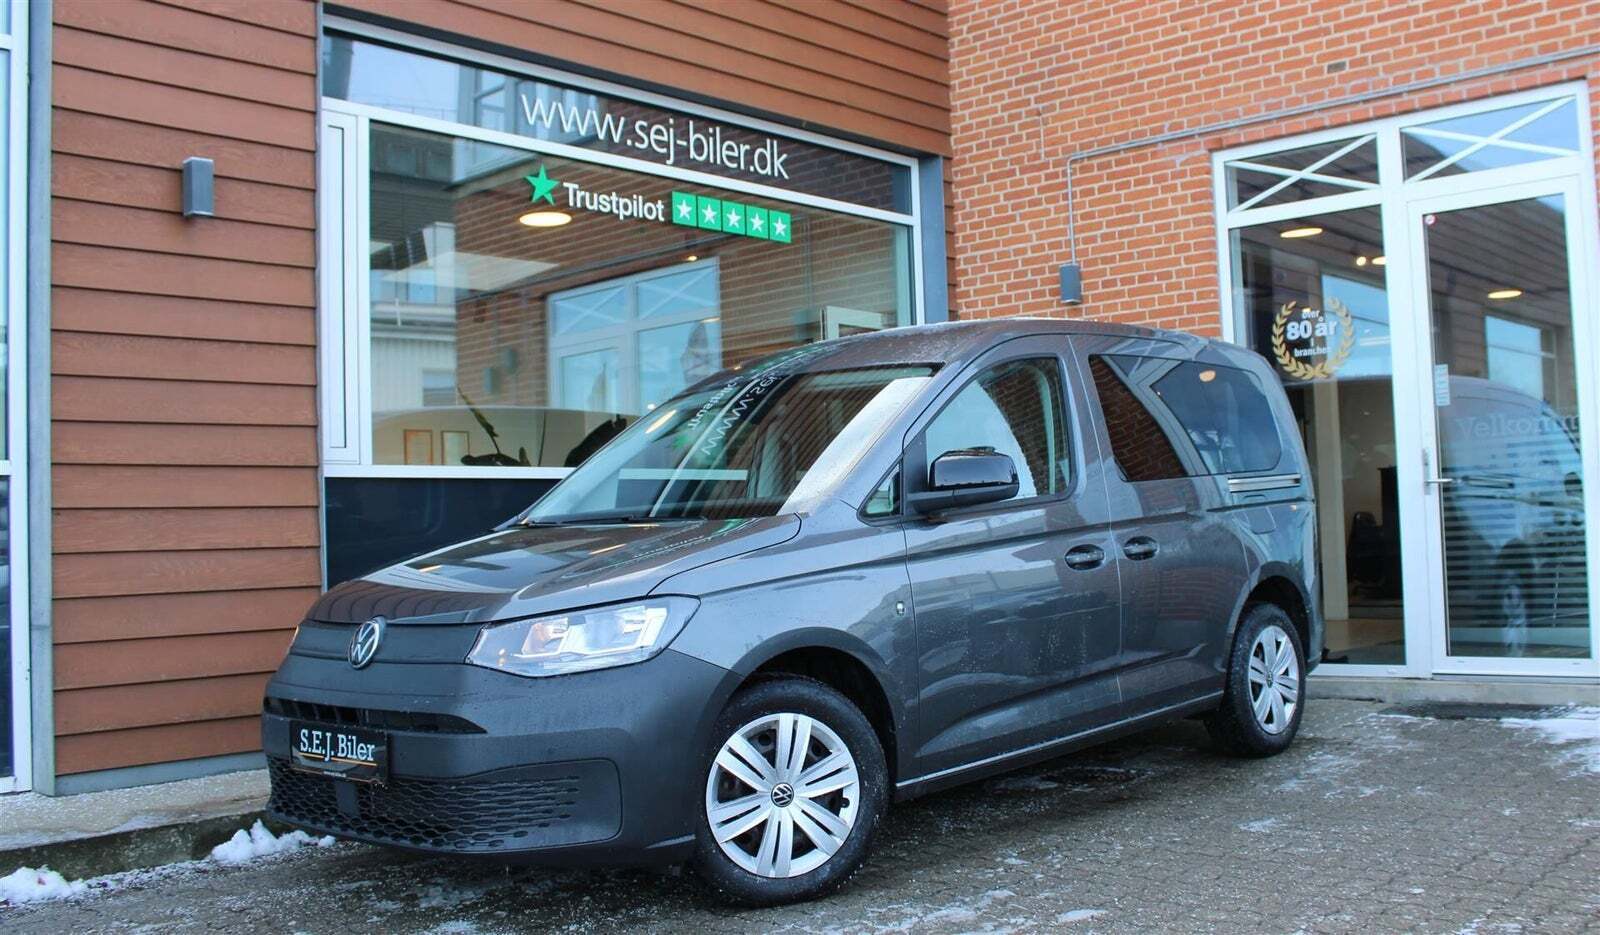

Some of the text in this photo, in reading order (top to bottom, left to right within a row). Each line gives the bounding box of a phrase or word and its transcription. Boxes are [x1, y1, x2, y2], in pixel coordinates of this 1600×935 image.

[521, 94, 790, 180] www.sej-biler.dk
[563, 182, 666, 222] Trustpilot
[1286, 316, 1338, 340] 80 år
[300, 729, 375, 762] S.E.J. Biler
